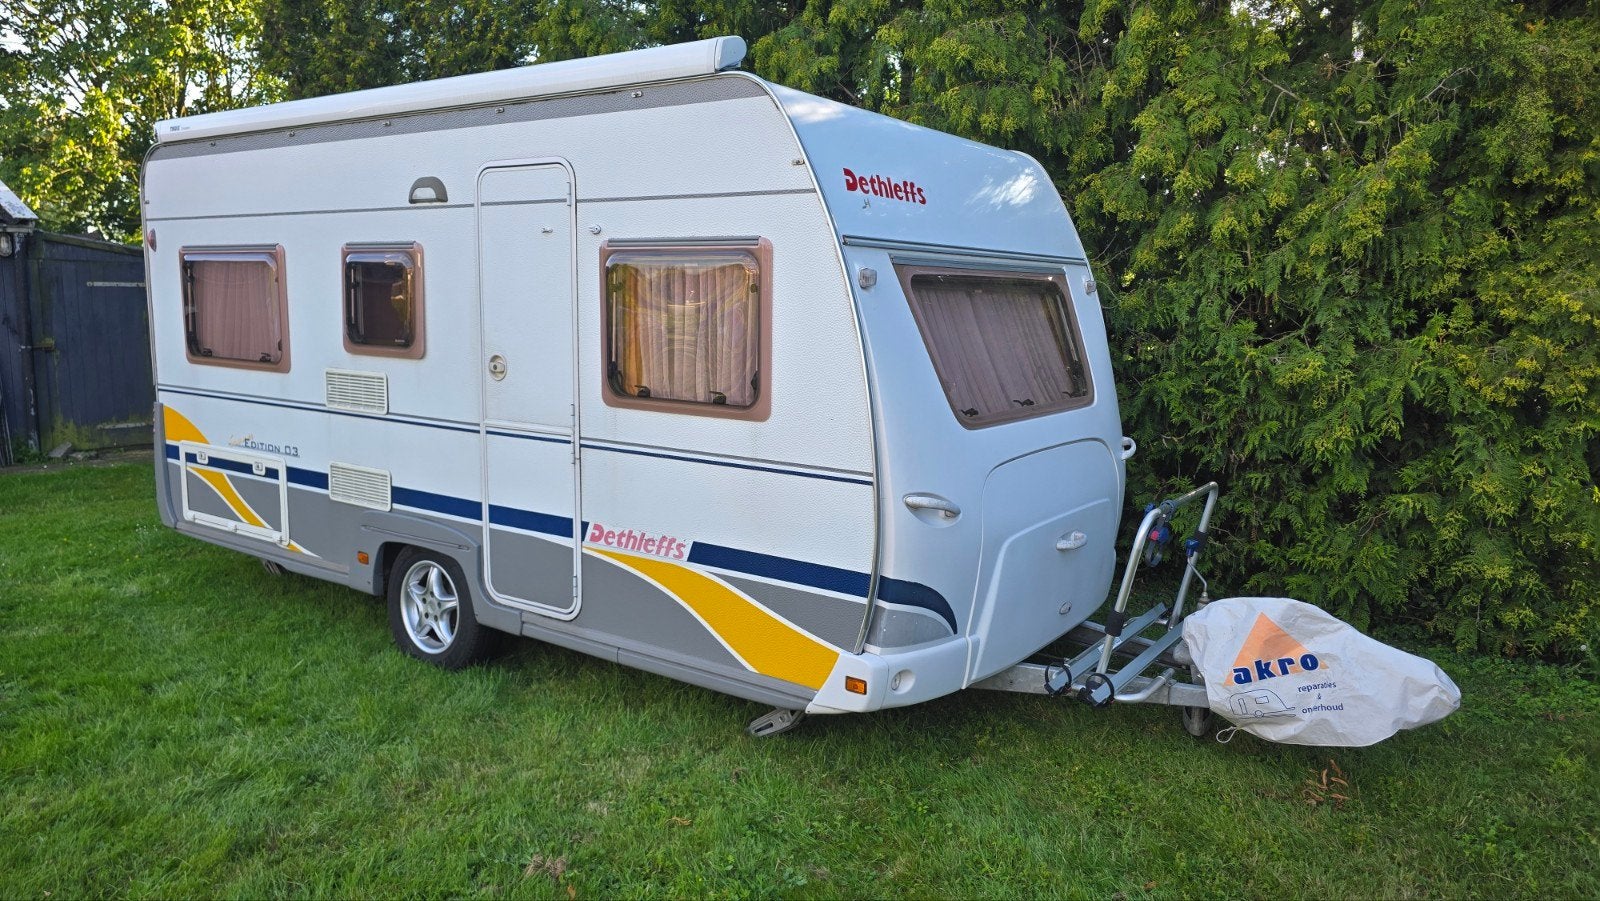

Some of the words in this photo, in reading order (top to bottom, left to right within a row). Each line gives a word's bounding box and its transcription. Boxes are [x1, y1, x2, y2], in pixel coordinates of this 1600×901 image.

[843, 168, 926, 205] Dethleffs
[284, 445, 299, 457] 03
[589, 523, 686, 560] Dethleffs
[1233, 654, 1319, 685] akro
